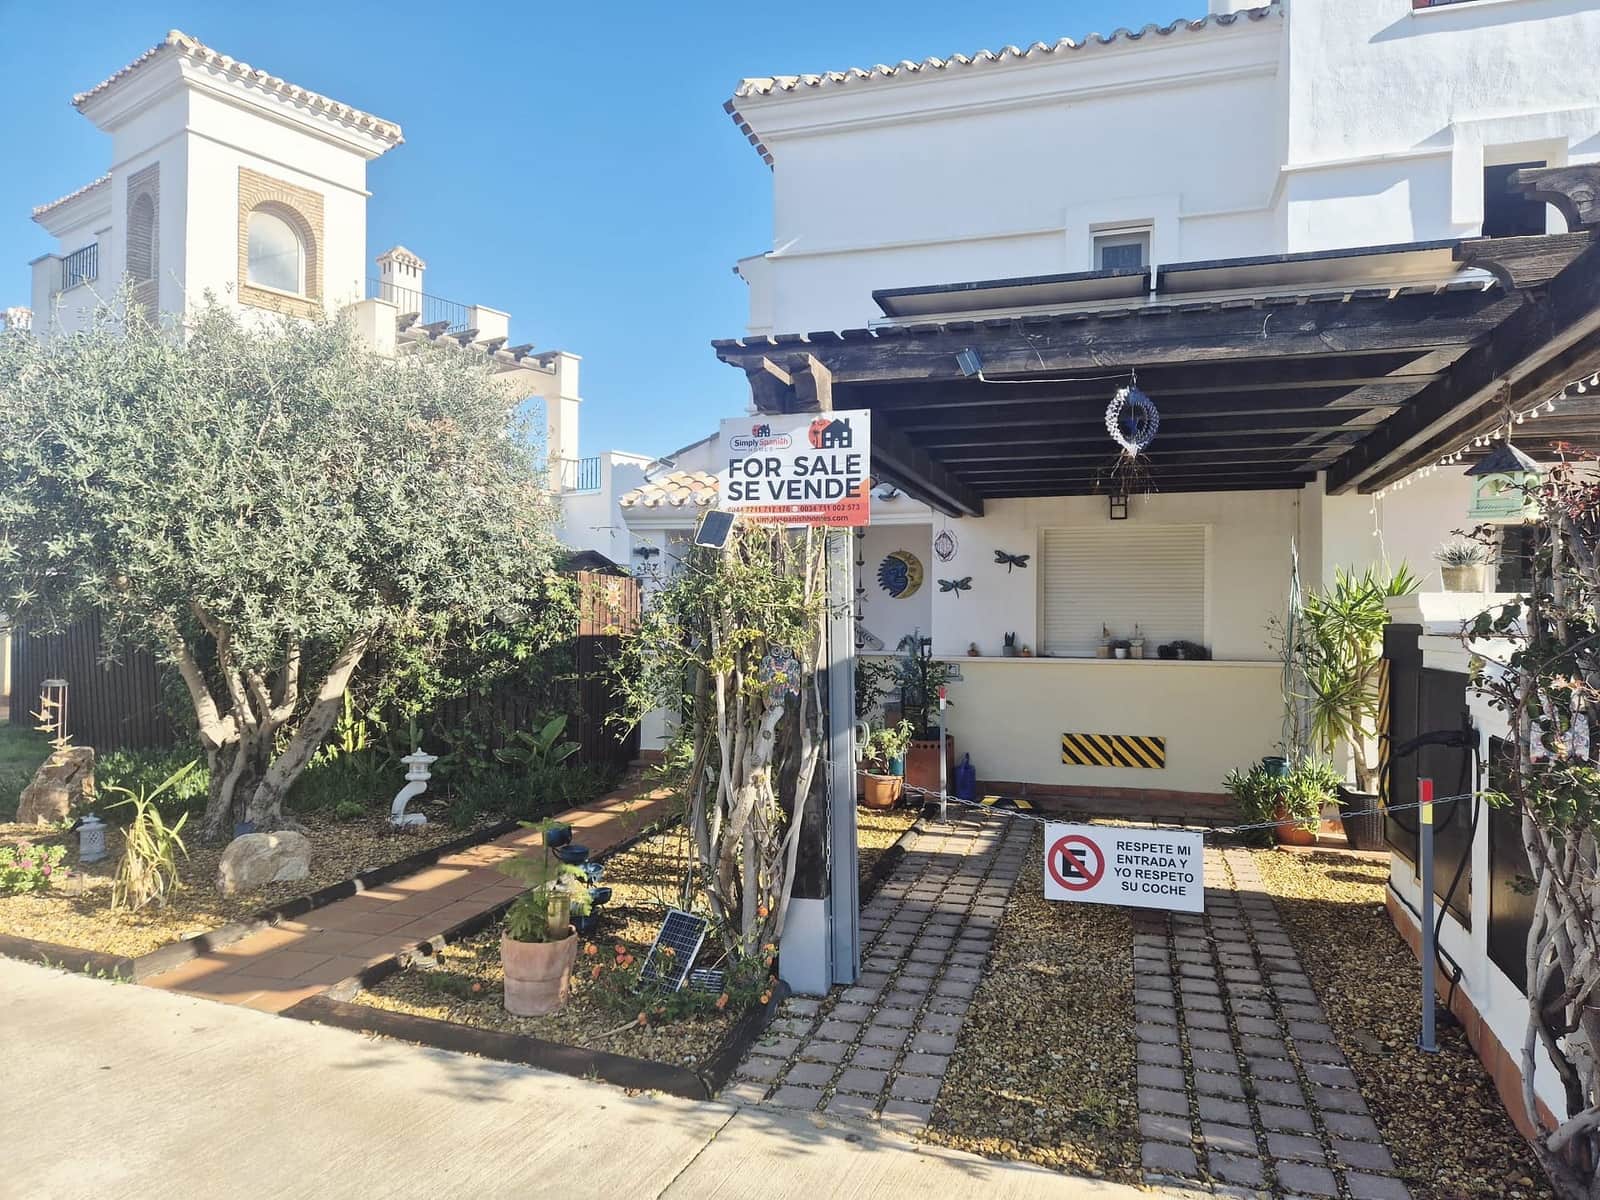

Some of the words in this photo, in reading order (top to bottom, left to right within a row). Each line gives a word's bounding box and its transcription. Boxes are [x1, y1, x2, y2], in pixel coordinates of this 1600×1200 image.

[729, 457, 782, 478] FOR
[793, 454, 861, 477] SALE
[728, 480, 760, 501] SE
[767, 477, 861, 501] VENDE
[1116, 840, 1174, 853] RESPETE
[1177, 845, 1191, 856] MI
[1062, 849, 1087, 878] E
[1116, 854, 1177, 868] ENTRADA
[1179, 859, 1188, 869] Y
[1114, 867, 1132, 878] YO
[1135, 869, 1194, 883] RESPETO
[1121, 881, 1138, 892] SU
[1141, 883, 1186, 896] COCHE
